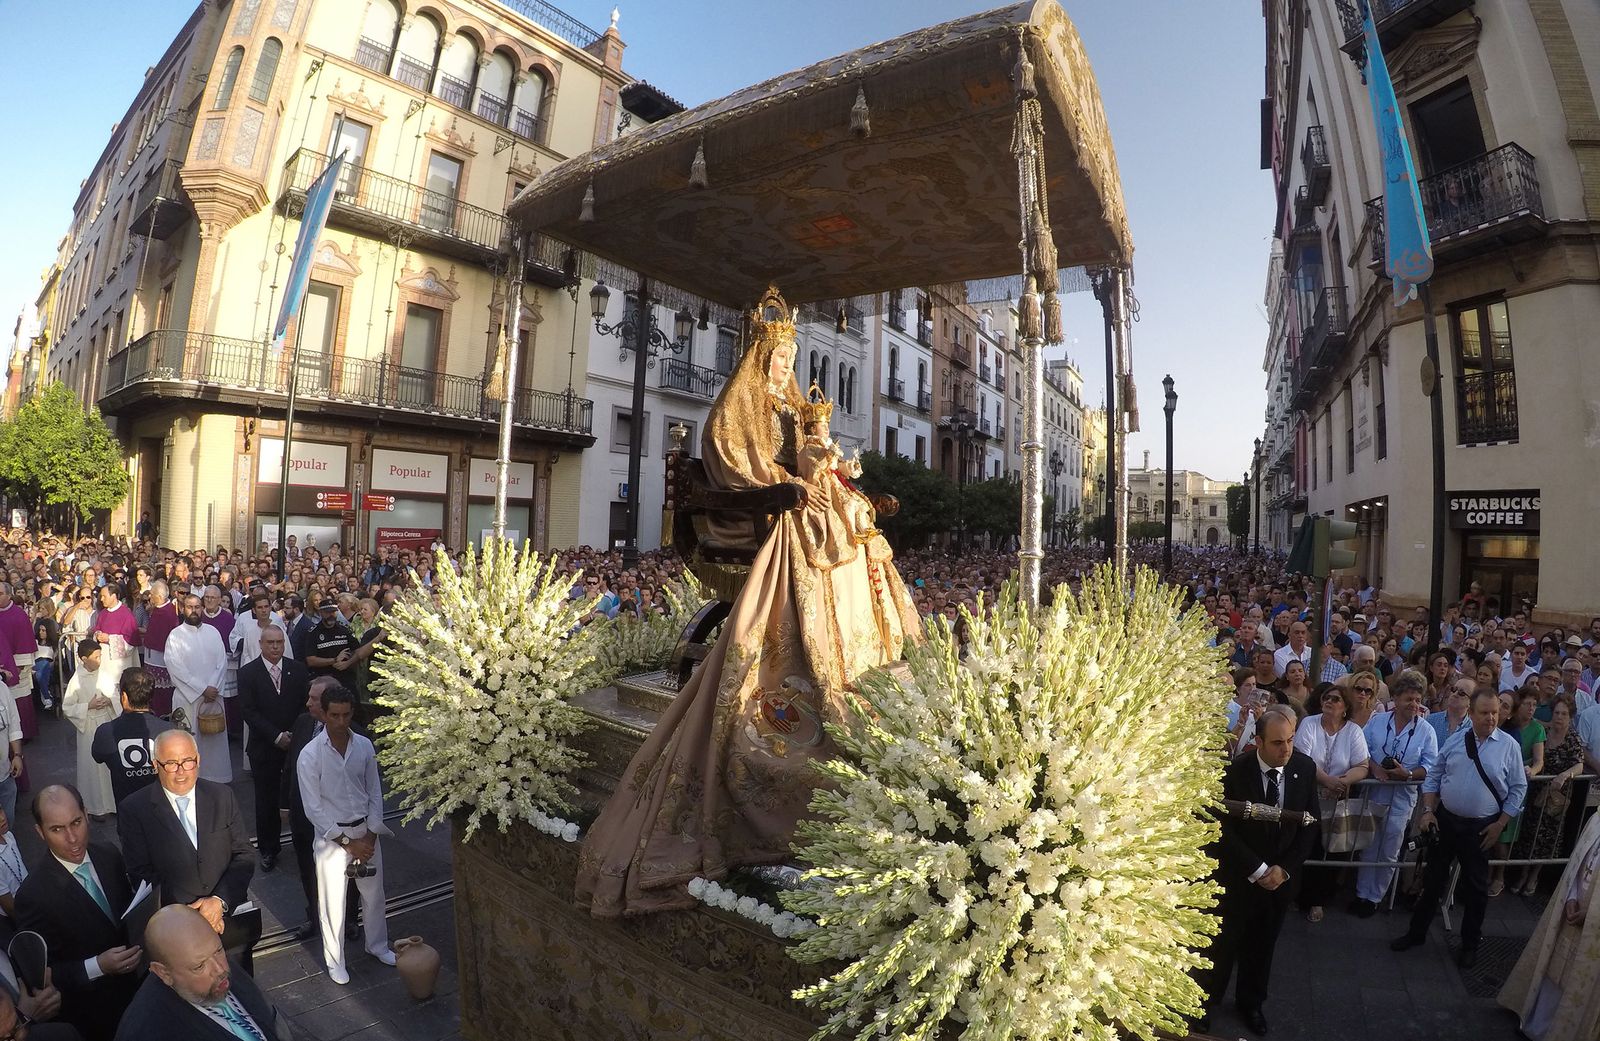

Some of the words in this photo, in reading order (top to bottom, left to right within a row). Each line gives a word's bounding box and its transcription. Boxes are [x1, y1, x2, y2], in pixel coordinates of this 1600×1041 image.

[390, 465, 431, 478] Popular
[484, 473, 520, 485] Polar
[1450, 497, 1541, 511] STARBUCKS
[1466, 512, 1524, 525] COFFEE
